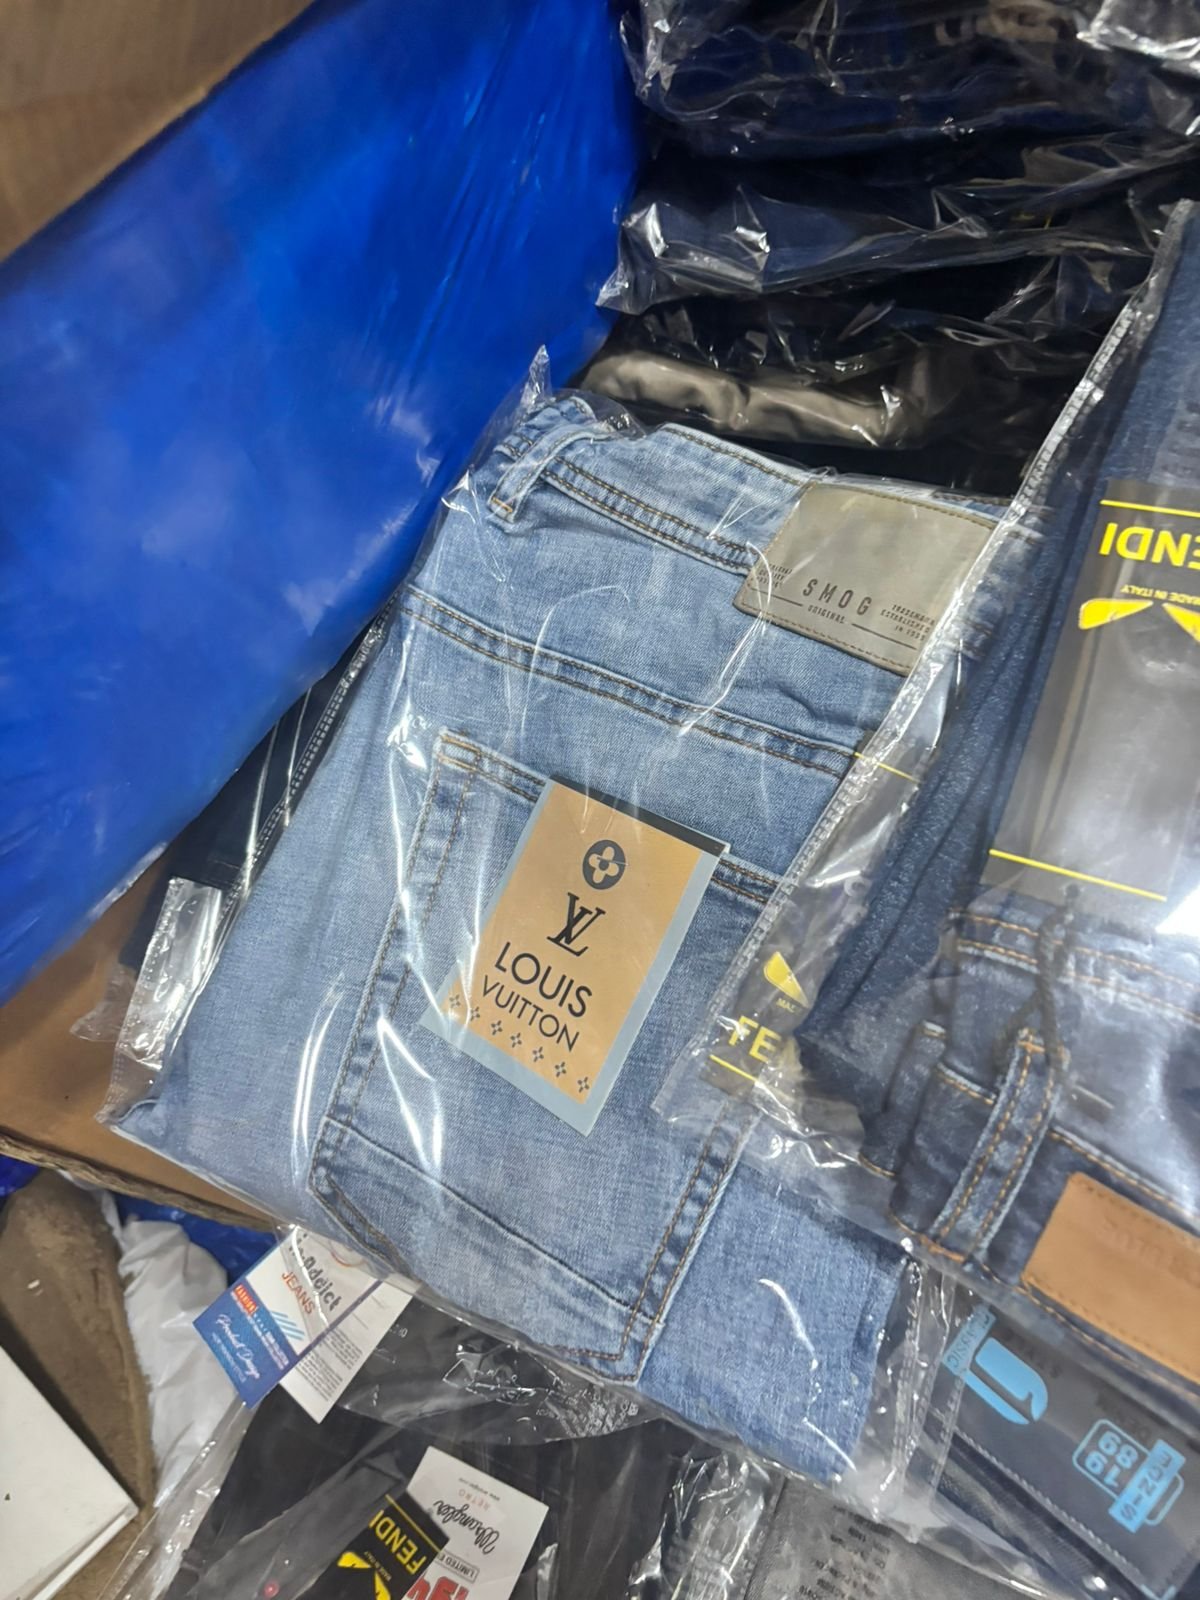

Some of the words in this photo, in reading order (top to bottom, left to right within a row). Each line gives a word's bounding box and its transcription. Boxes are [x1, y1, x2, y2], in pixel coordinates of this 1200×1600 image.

[803, 578, 872, 615] SMOG
[1121, 584, 1152, 598] ITALY
[1154, 589, 1168, 600] IN
[547, 892, 606, 957] LV
[494, 941, 592, 1018] LOUIS
[482, 974, 580, 1052] VUITTON
[282, 1271, 315, 1315] JEANS
[1084, 1451, 1121, 1488] 19
[1098, 1430, 1139, 1469] 89
[458, 1488, 491, 1512] RETRO
[1120, 1452, 1174, 1521] SINCE
[369, 1509, 427, 1575] FENDI
[433, 1500, 499, 1555] Wrangler
[443, 1555, 476, 1577] LIMITED
